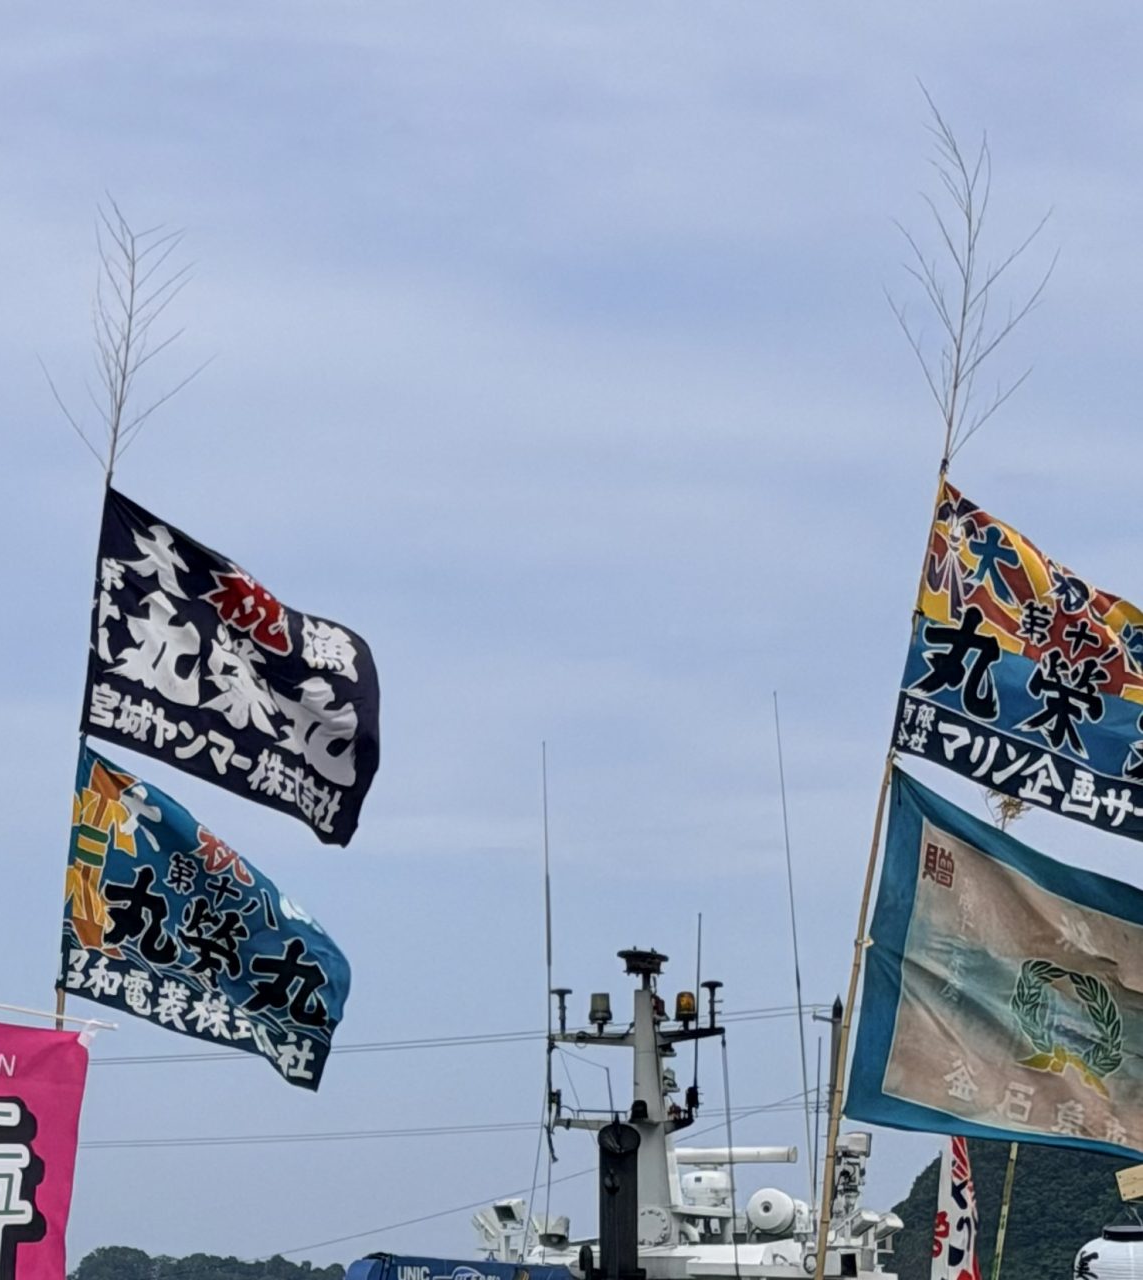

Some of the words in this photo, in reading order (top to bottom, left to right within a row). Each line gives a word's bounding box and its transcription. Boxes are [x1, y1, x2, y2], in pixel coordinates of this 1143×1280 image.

[89, 683, 343, 834] 宮城ヤンマー株式会社
